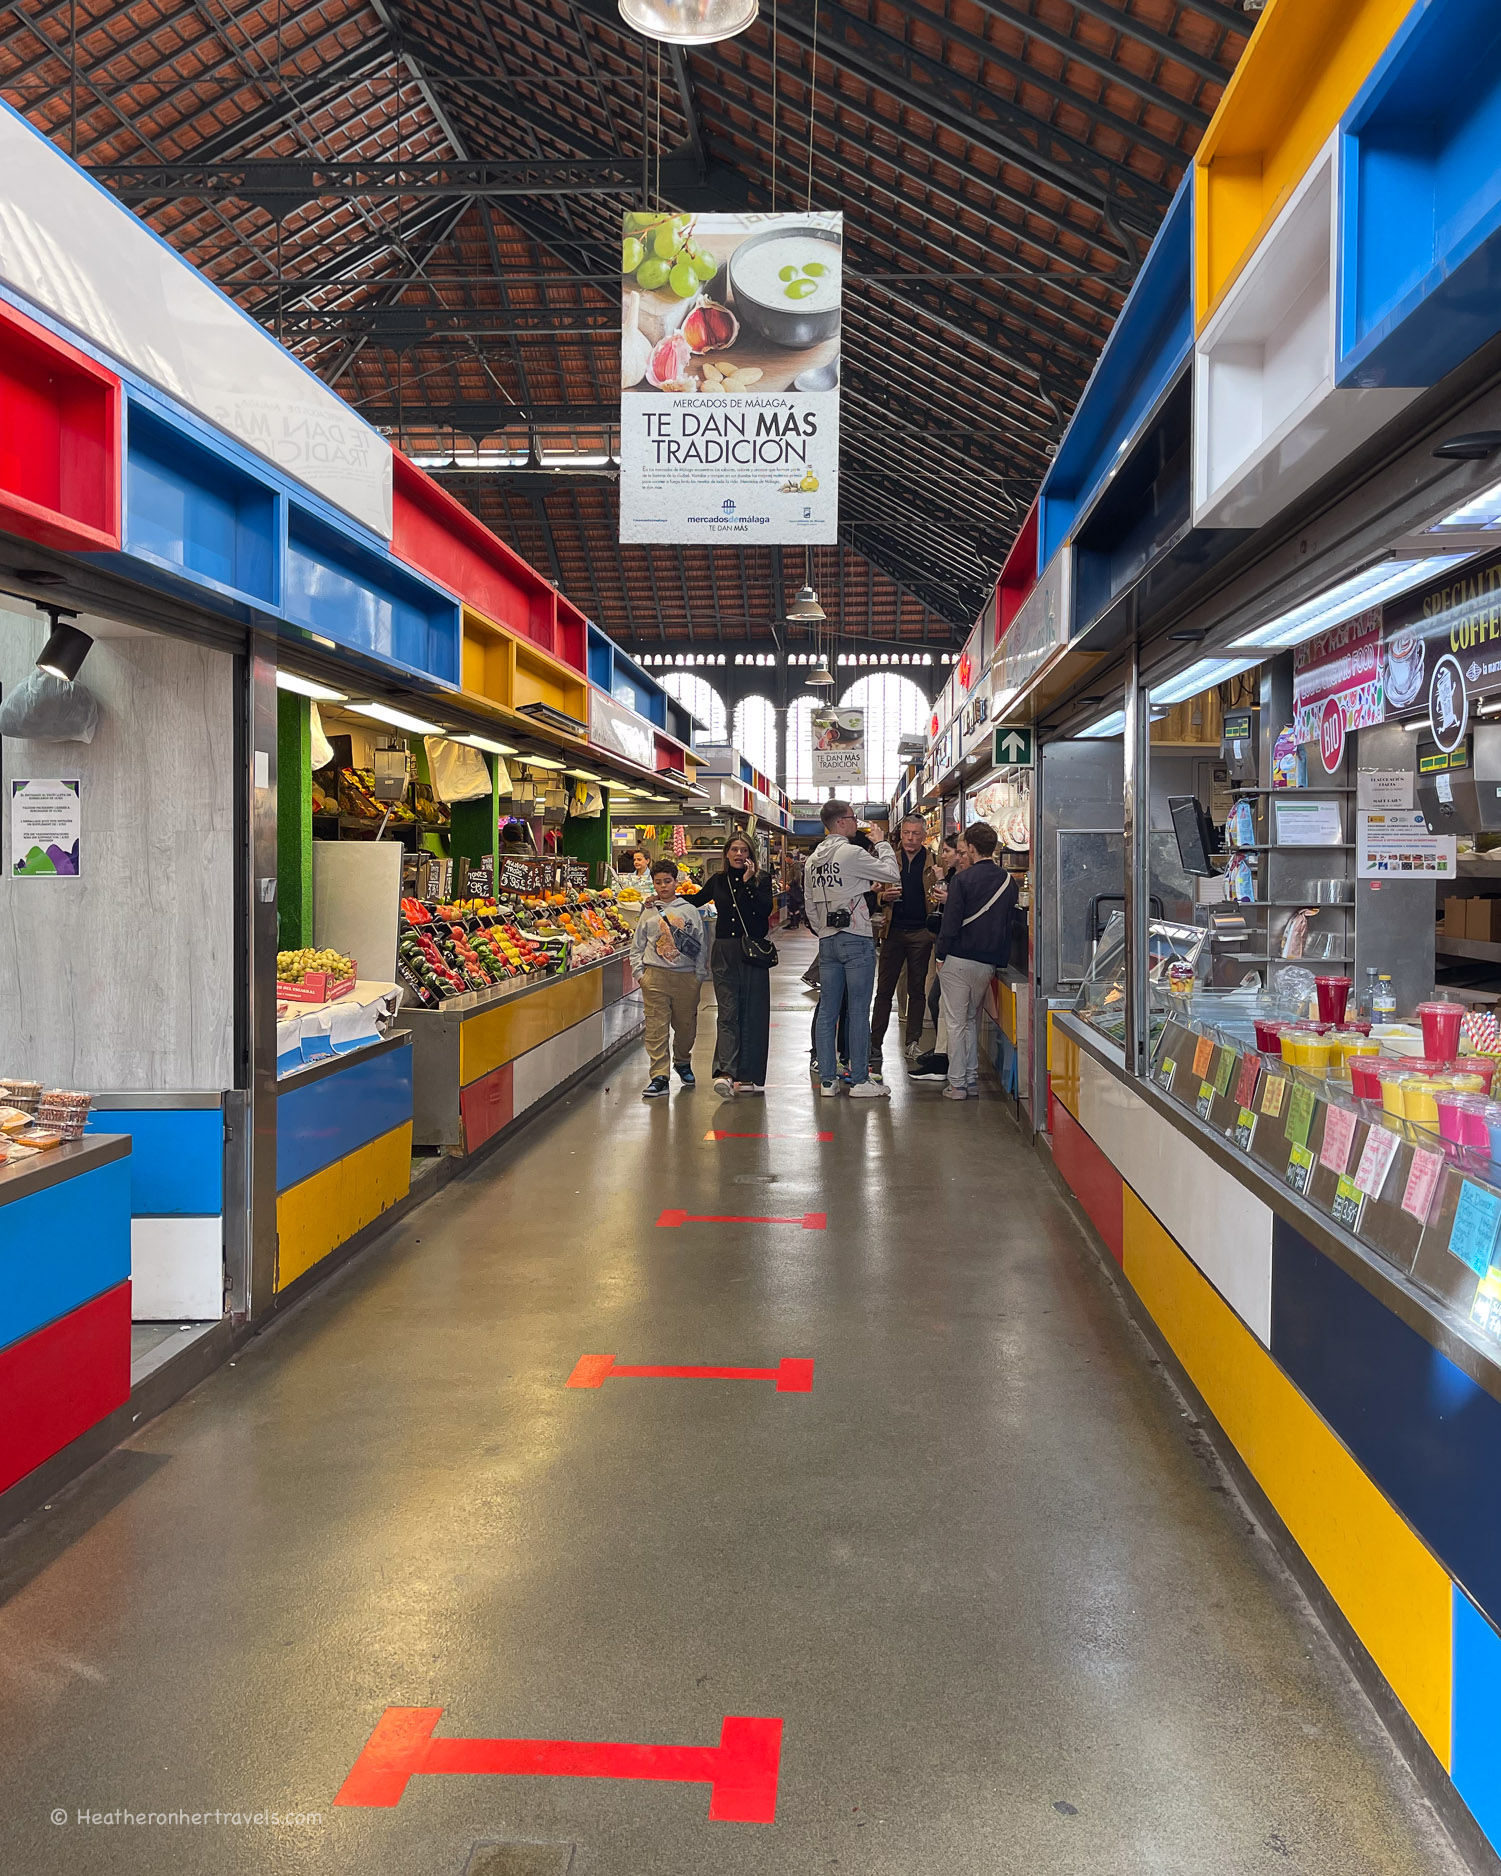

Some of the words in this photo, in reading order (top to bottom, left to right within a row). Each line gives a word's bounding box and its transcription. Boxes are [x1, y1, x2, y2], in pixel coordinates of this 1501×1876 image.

[673, 399, 728, 408] MERCADOS
[730, 399, 743, 408] DE
[744, 396, 788, 408] MÁLAGA
[642, 413, 671, 437] TE
[682, 412, 745, 437] DAN
[755, 404, 817, 437] MÁS
[651, 437, 806, 464] TRADICIÓN
[1450, 602, 1501, 653] COFFE
[1323, 712, 1340, 758] BIO
[812, 875, 843, 888] 2024
